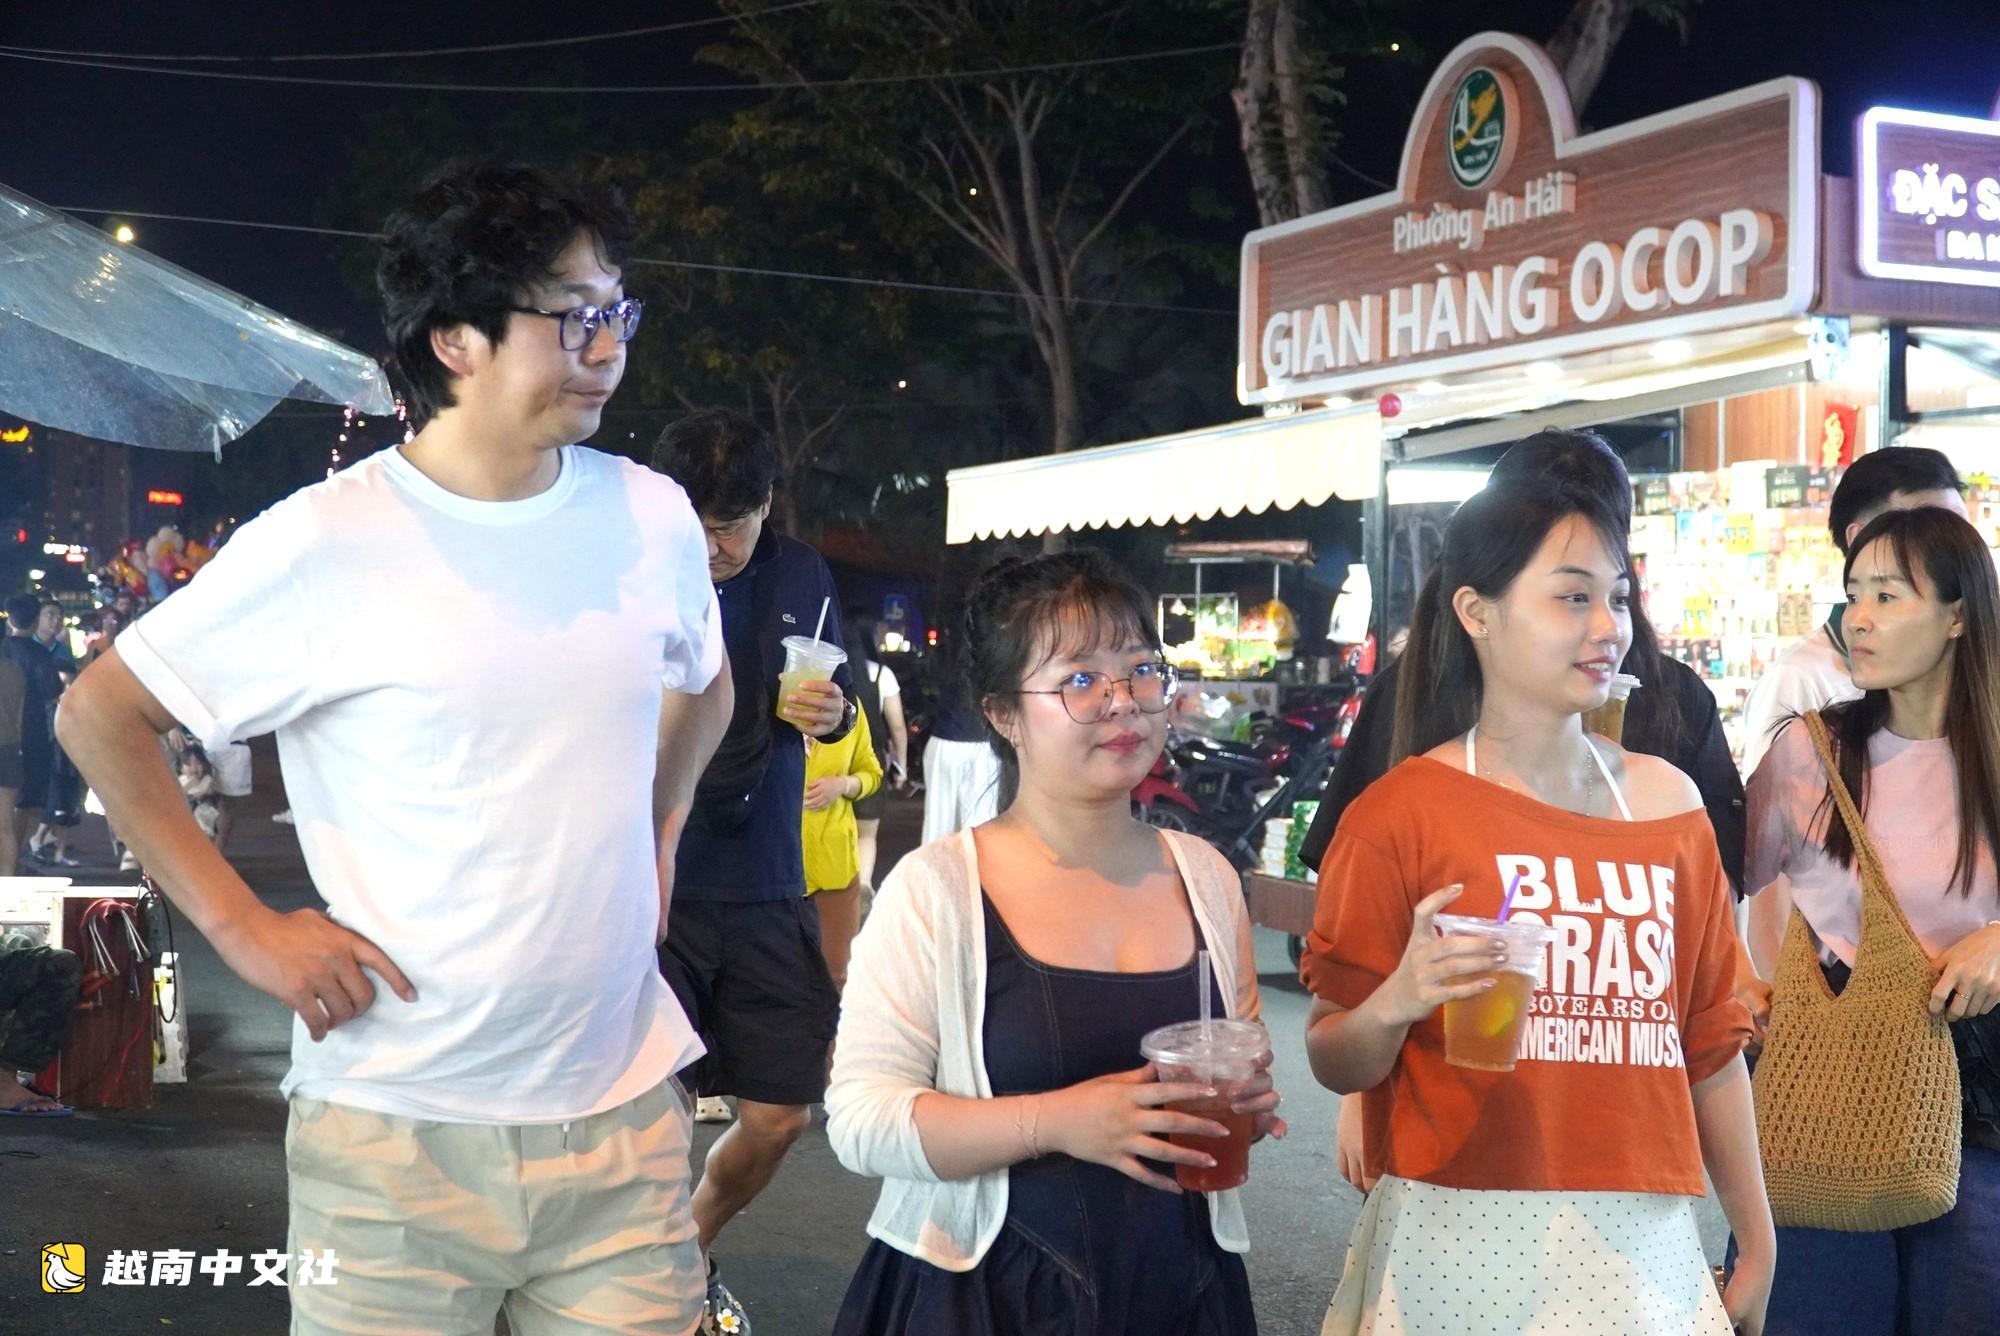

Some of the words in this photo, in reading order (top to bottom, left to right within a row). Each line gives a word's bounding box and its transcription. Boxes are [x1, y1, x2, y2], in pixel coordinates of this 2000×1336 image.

[1394, 201, 1473, 253] Phường
[1484, 191, 1516, 231] An
[1524, 171, 1564, 220] Hải
[1891, 163, 1968, 225] ĐẶC
[1976, 177, 2000, 222] S
[1263, 294, 1371, 379] GIAN
[1389, 255, 1549, 357] HÀNG
[1571, 208, 1759, 323] OCOP
[1517, 1016, 1623, 1065] MERICAN
